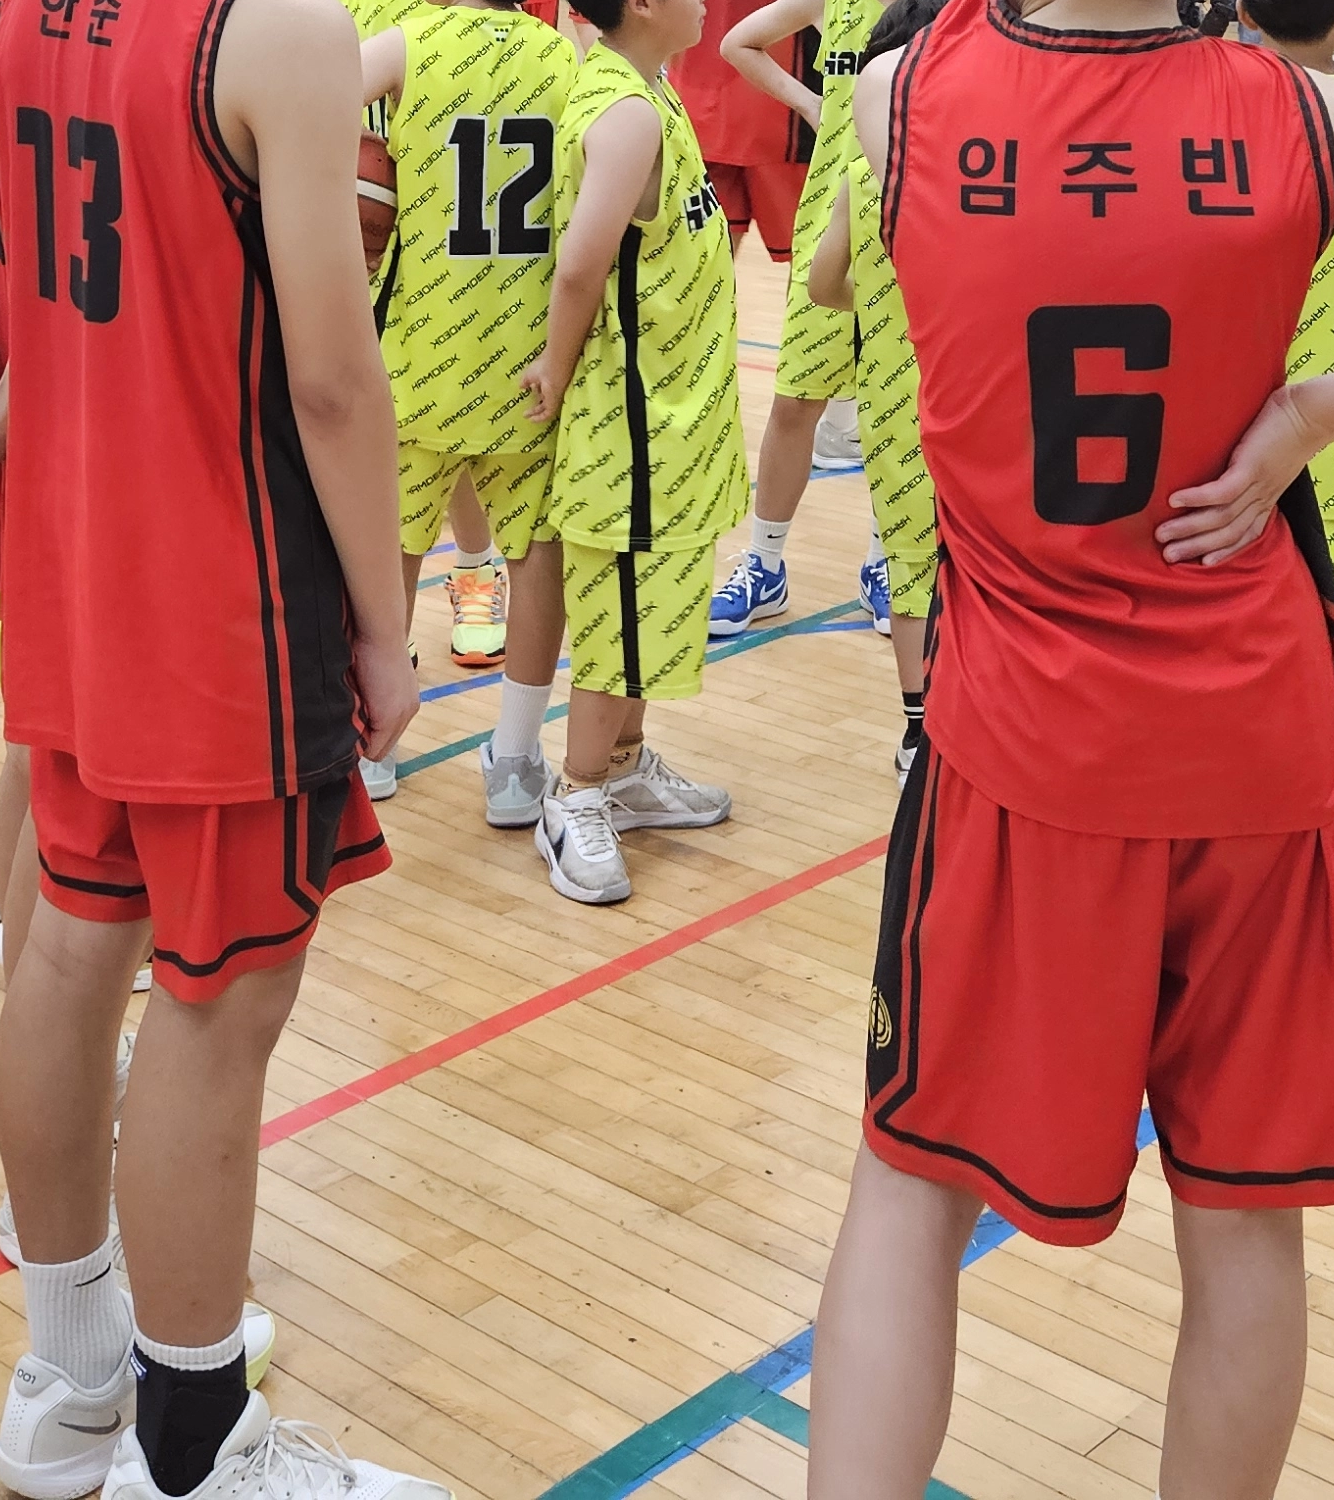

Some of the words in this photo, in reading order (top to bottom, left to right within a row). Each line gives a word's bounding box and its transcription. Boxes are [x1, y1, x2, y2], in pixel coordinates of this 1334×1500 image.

[449, 40, 494, 80] HAMDEOK
[425, 88, 473, 132] HAMDEOK
[515, 73, 559, 115] HAMDEOK
[448, 117, 554, 256] 12
[17, 106, 123, 324] 13
[448, 261, 495, 304] HAMDEOK
[430, 309, 480, 349] HAMDEOK
[477, 298, 525, 342] HAMDEOK
[803, 327, 843, 355] HAMDEOK
[411, 354, 460, 392] HAMDEOK
[459, 346, 508, 390] HAMDEOK
[438, 391, 490, 432] HAMDEOK
[1026, 303, 1172, 526] 6
[507, 453, 551, 493] HAMDEOK
[885, 470, 928, 507] HAMDEOK
